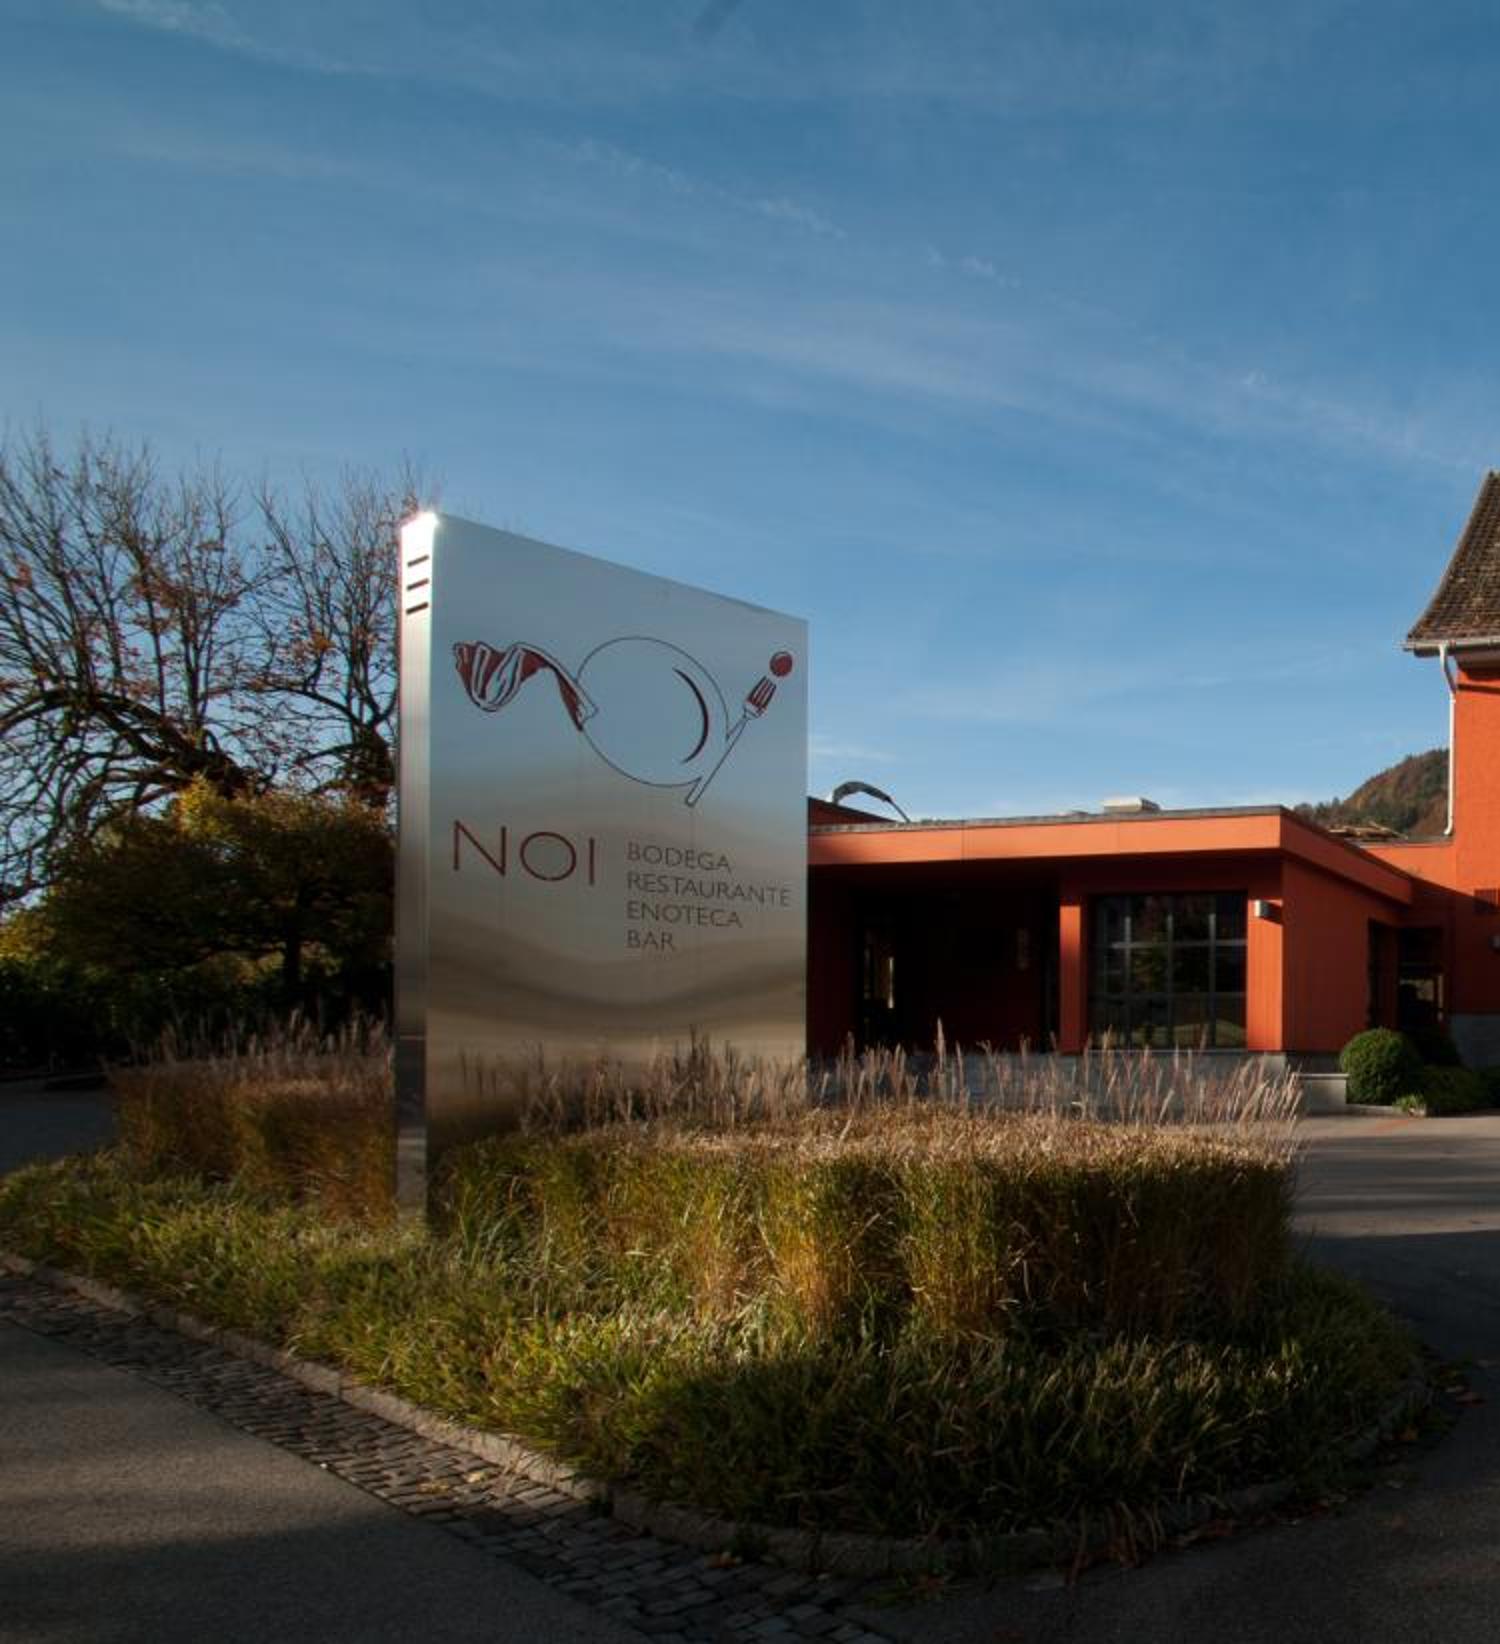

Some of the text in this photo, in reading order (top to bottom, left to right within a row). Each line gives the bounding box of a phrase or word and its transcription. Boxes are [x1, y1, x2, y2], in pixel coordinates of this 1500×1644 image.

[453, 820, 597, 886] NOI
[627, 842, 731, 873] BODEGA
[627, 872, 791, 907] RESTAURANTE
[627, 901, 743, 929] ENOTECA
[627, 929, 675, 951] BAR
